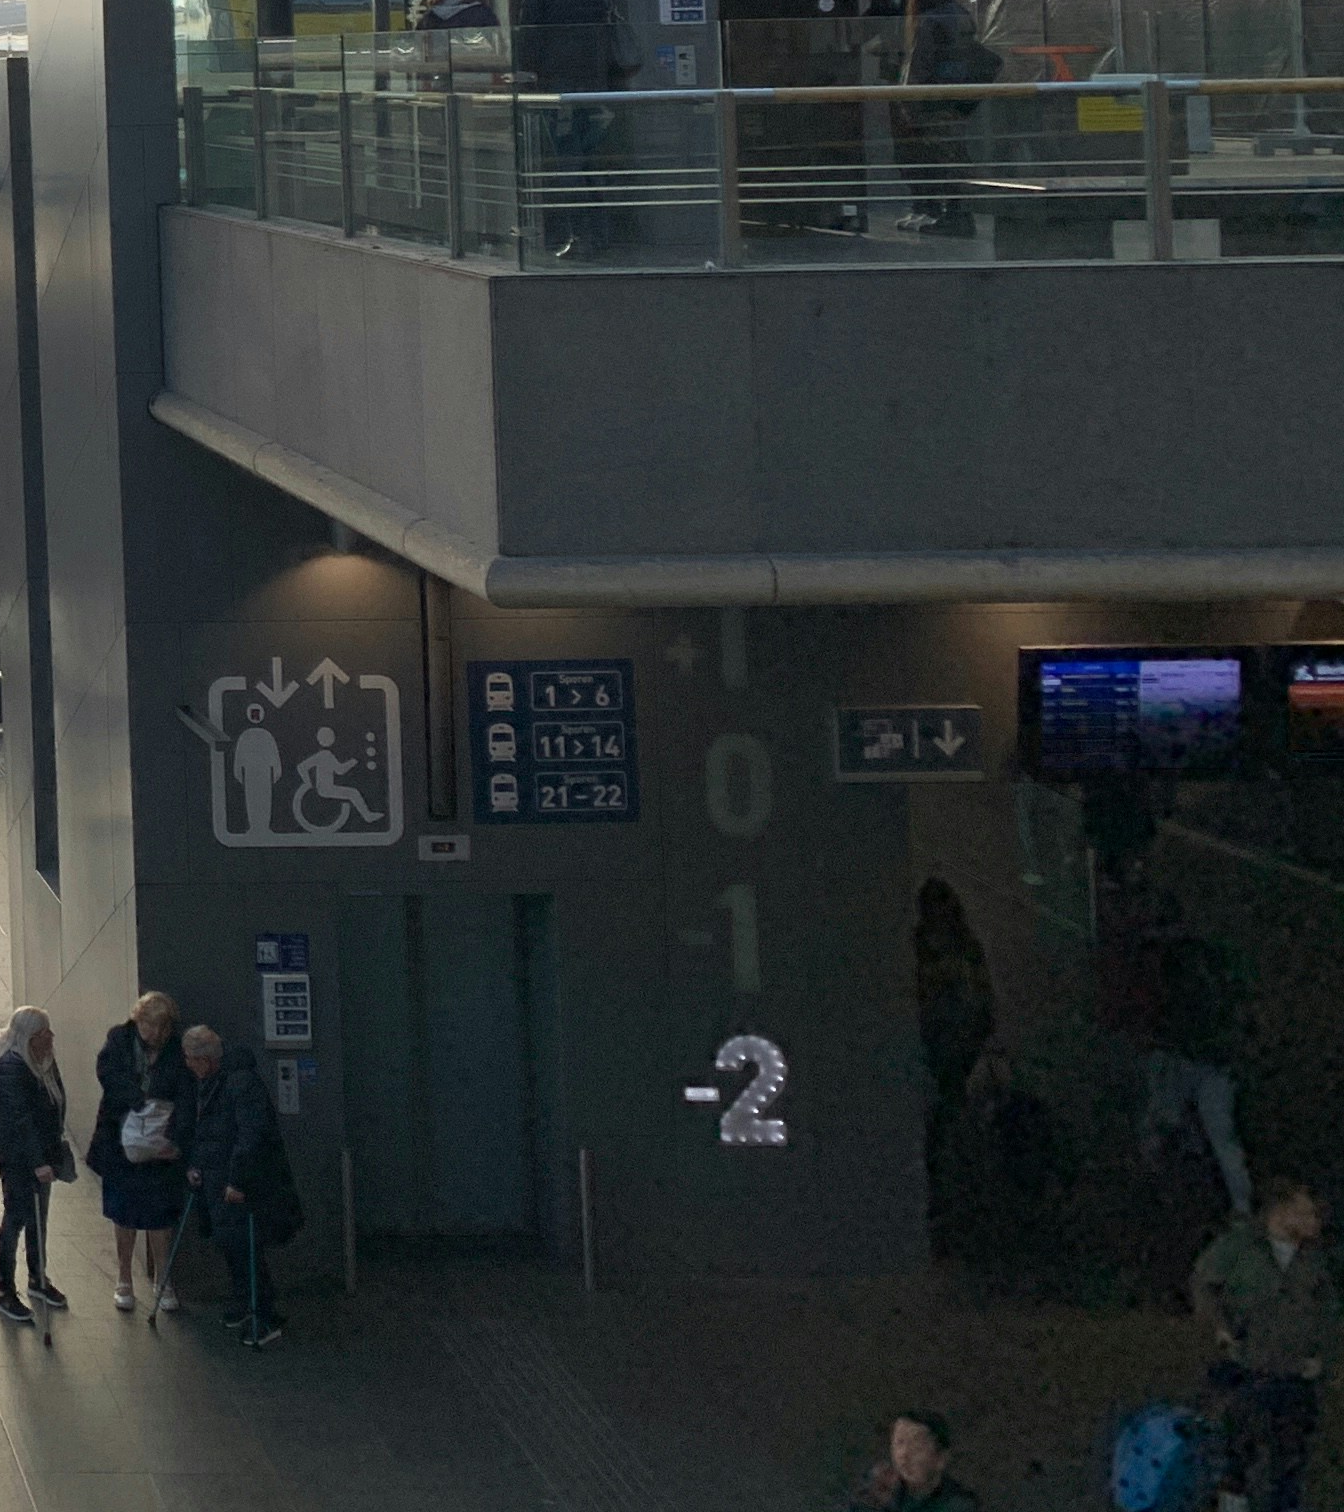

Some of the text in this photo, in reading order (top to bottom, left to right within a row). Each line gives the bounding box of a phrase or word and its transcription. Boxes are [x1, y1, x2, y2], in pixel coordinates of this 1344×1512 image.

[545, 685, 555, 707] 1
[595, 684, 610, 706] 6
[559, 674, 594, 685] Sporen
[704, 733, 772, 838] 0
[683, 1034, 790, 1147] -2
